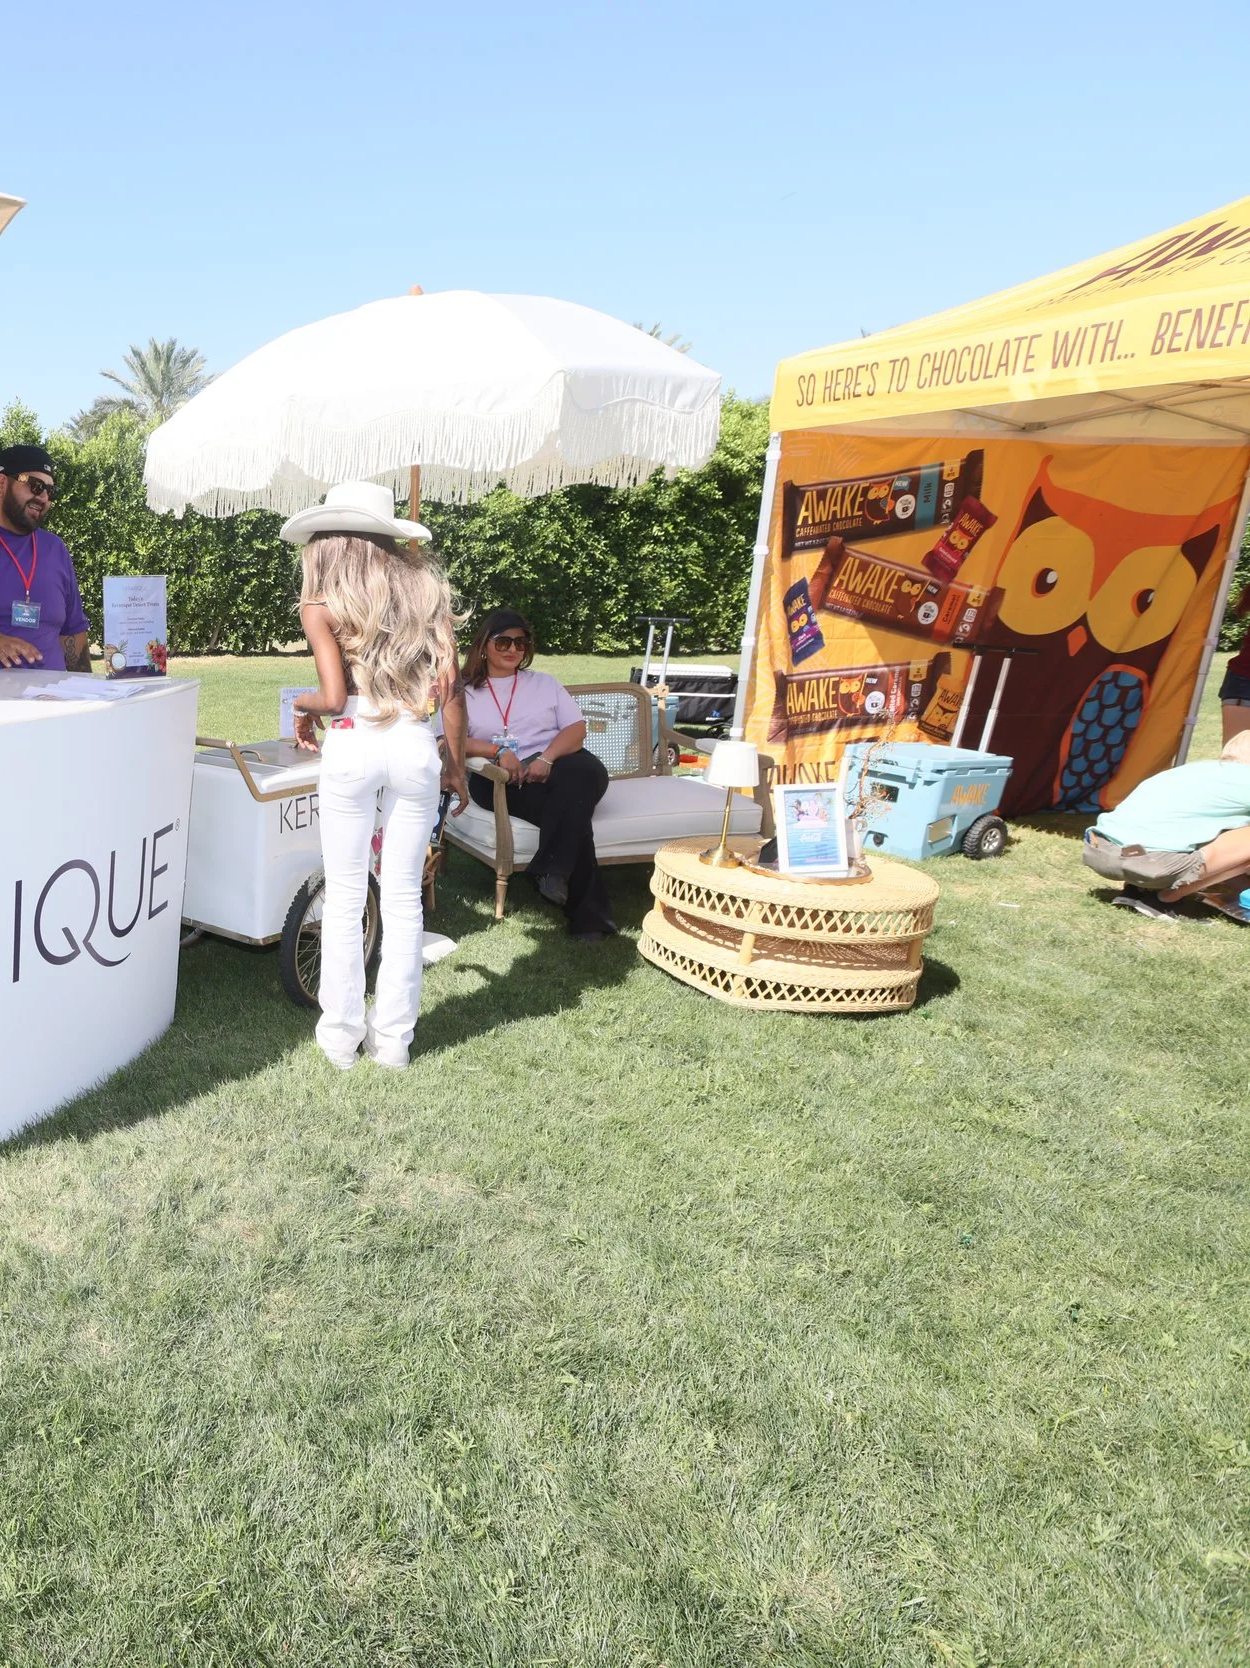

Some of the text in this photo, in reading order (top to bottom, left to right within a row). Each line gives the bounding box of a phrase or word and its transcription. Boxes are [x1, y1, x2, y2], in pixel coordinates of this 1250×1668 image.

[796, 374, 816, 407] SO
[823, 361, 879, 403] HERE'S
[888, 356, 911, 394] TO
[917, 333, 1043, 389] CHOCOLATE
[796, 482, 870, 526] AWAKE
[923, 482, 932, 504] Milk
[958, 513, 984, 537] AWAKE
[833, 556, 906, 604] AWAKE
[15, 616, 36, 624] VENDOR
[786, 677, 840, 716] AWAKE
[952, 783, 991, 806] AWAKE
